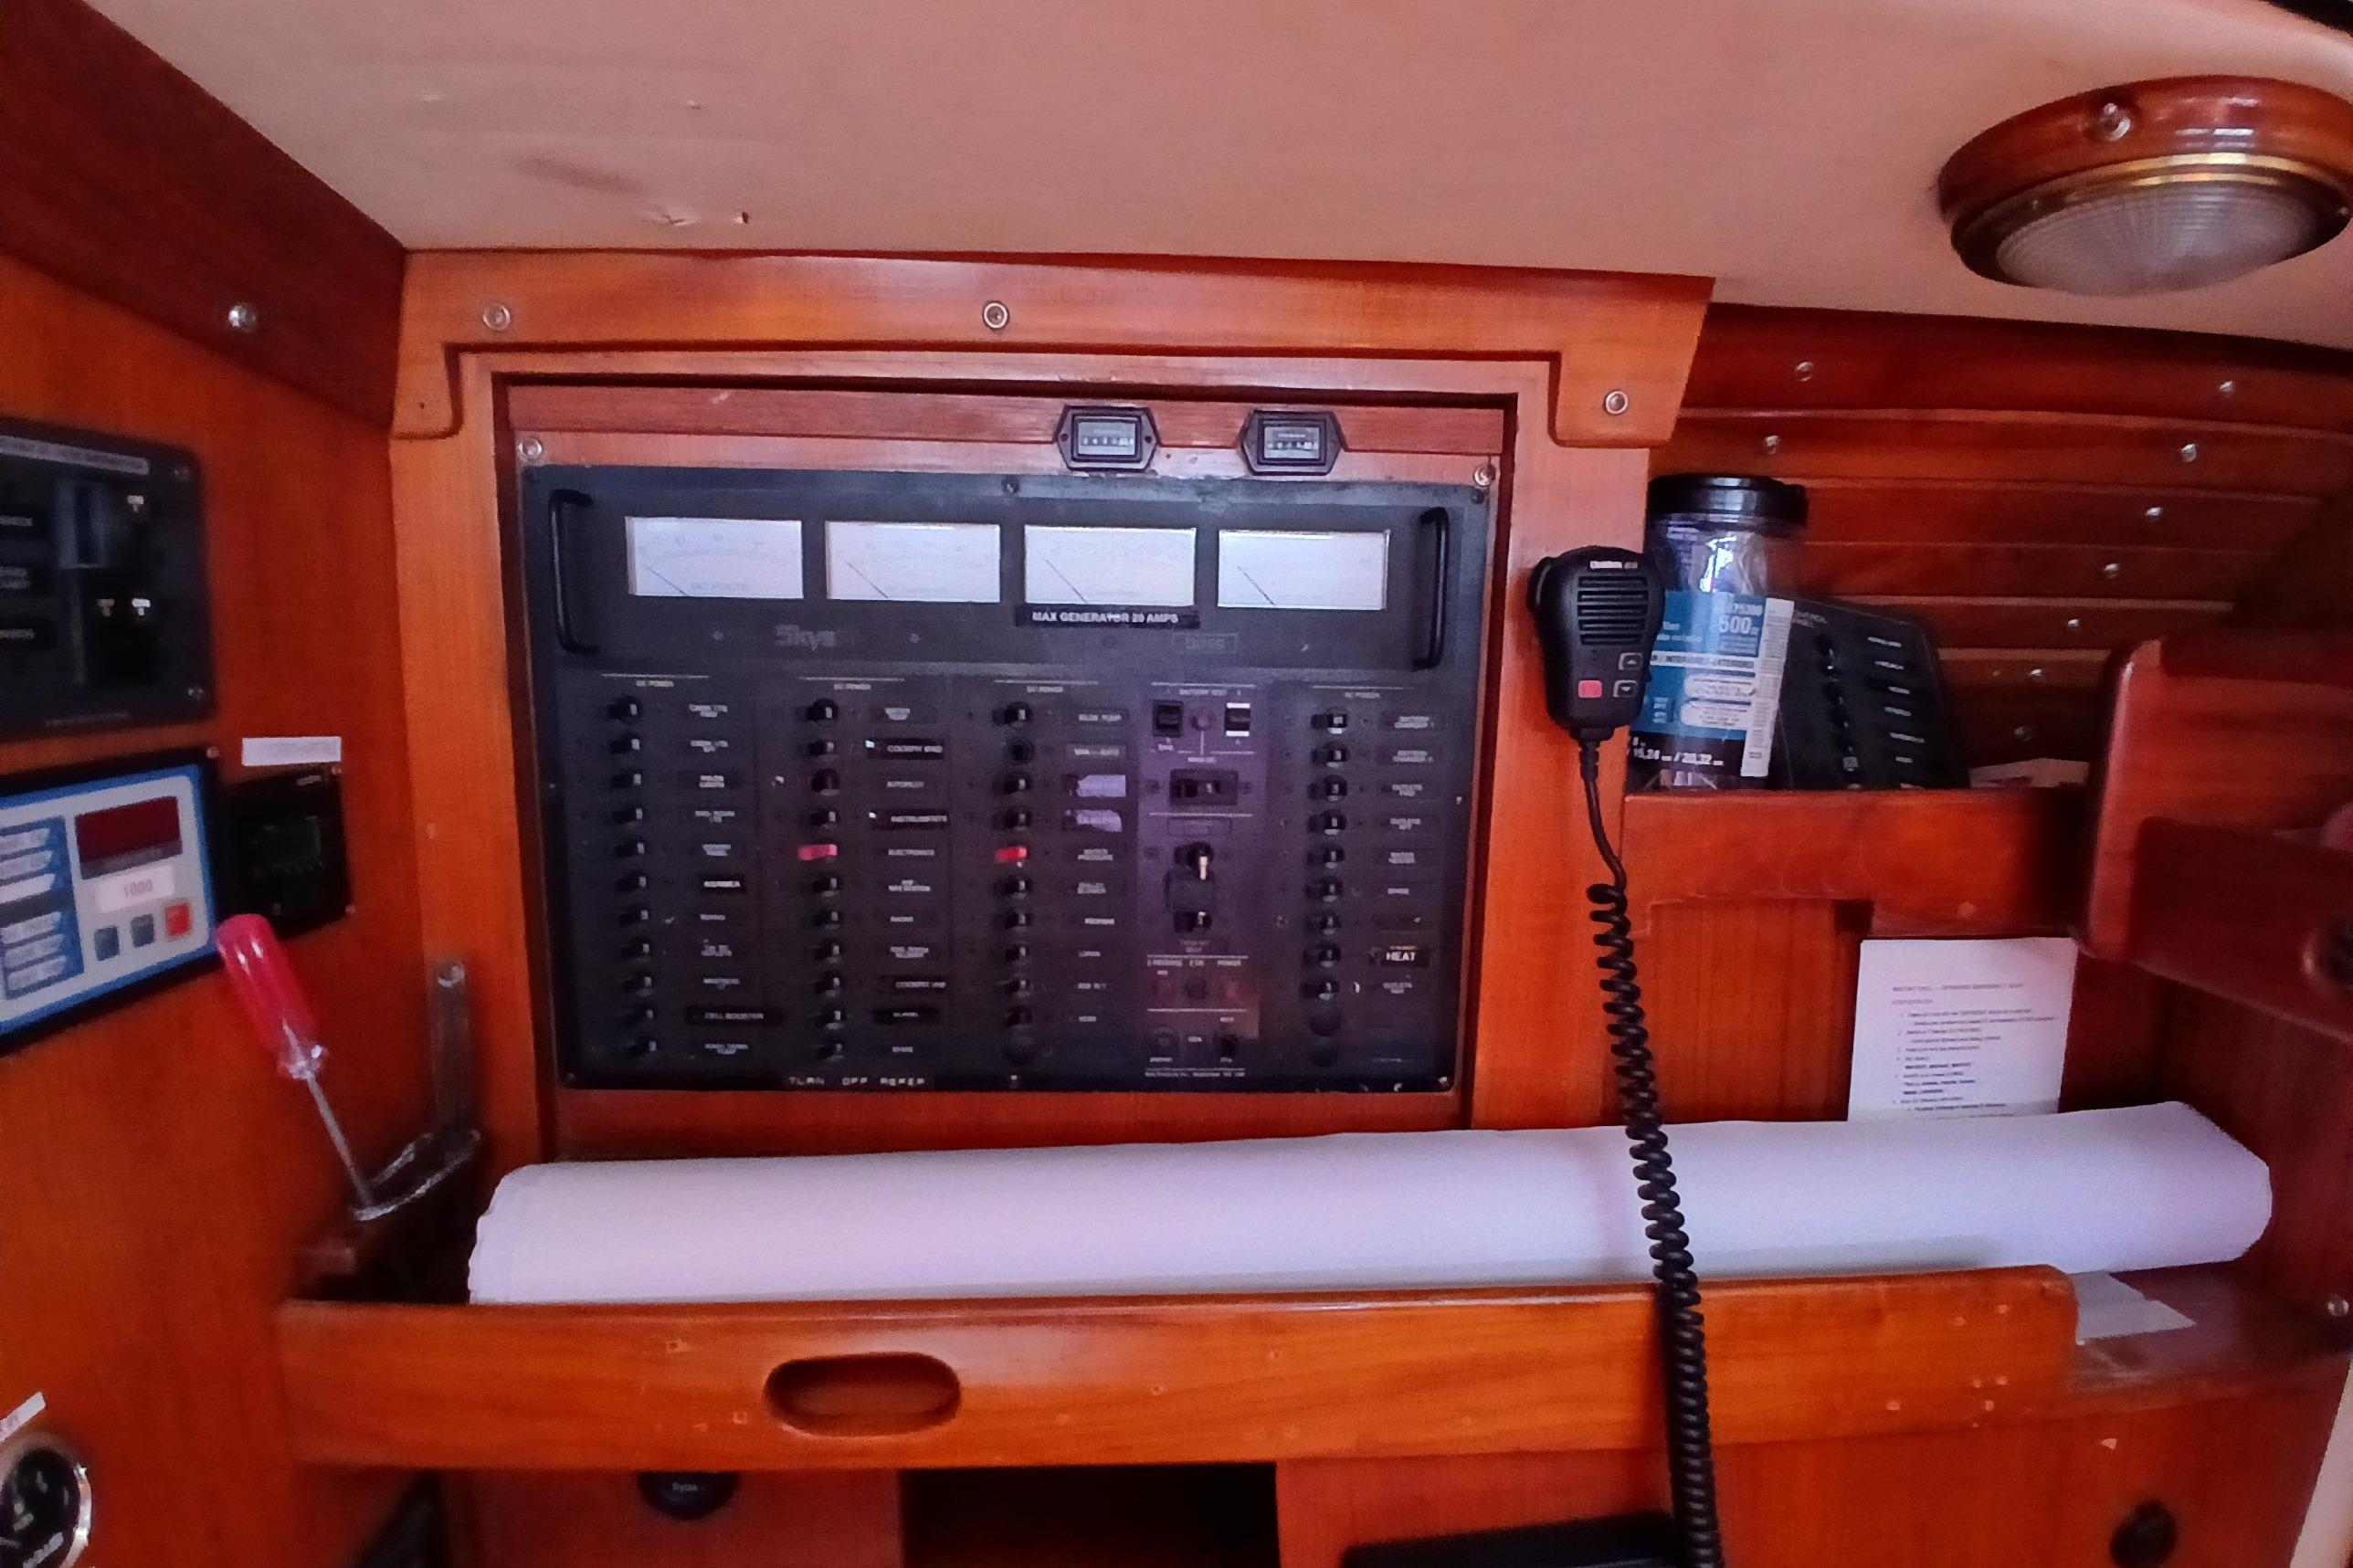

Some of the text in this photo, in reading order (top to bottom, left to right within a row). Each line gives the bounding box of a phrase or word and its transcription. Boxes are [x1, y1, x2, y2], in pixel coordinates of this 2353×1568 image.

[1031, 611, 1058, 622] MAX
[1060, 611, 1130, 623] GENERATOR
[1146, 613, 1179, 624] AMPS
[1718, 616, 1752, 635] 500
[1386, 951, 1416, 962] HEAT
